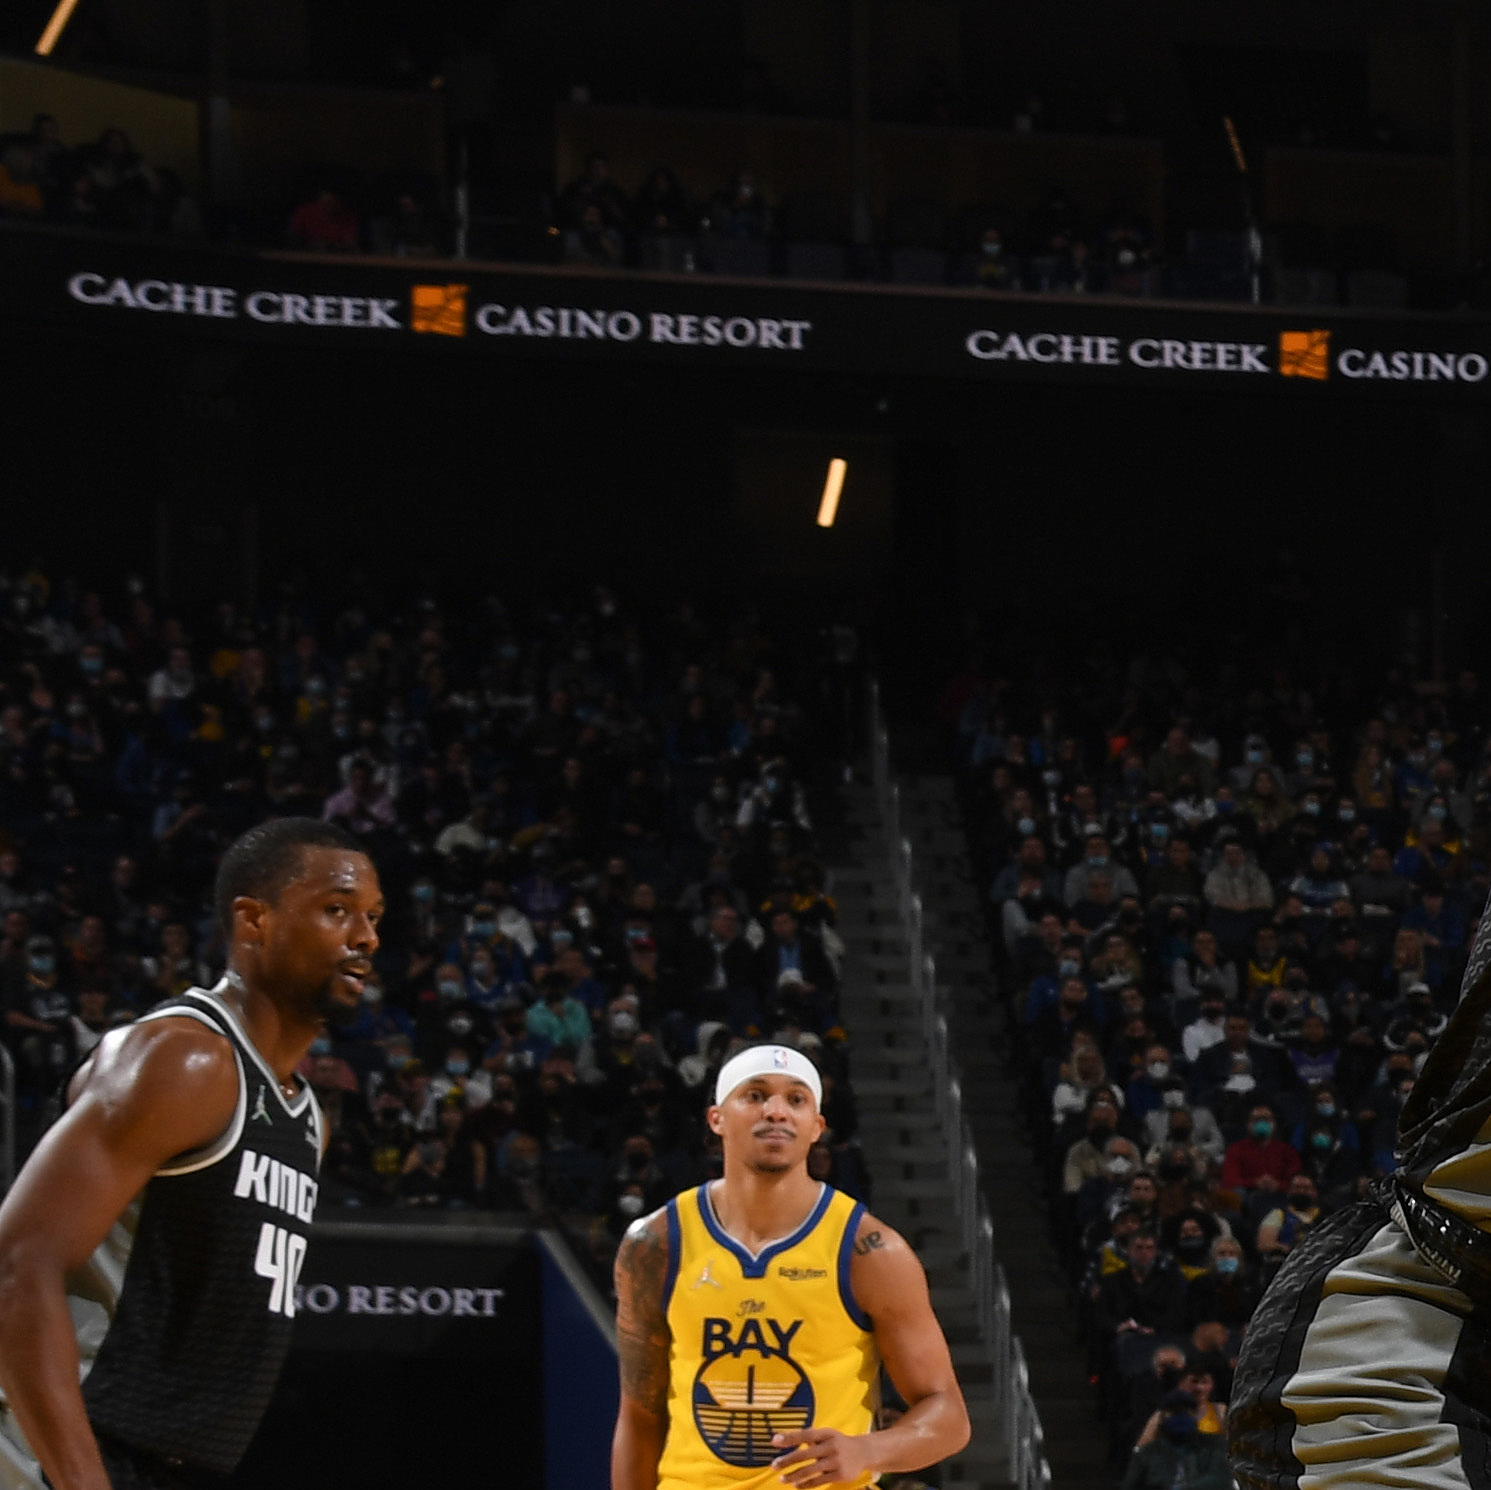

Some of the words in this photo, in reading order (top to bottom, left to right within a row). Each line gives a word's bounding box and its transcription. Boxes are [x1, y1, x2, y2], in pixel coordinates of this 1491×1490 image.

[68, 271, 236, 318] CACHE
[245, 291, 402, 330] CREEK
[475, 304, 642, 342] CASINO
[650, 312, 812, 351] RESORT
[965, 330, 1120, 367] CACHE
[1129, 338, 1270, 374] CREEK
[1338, 349, 1489, 384] CASINO
[233, 1148, 320, 1225] KING
[778, 1266, 828, 1280] Rakuten
[346, 1284, 504, 1318] RESORT
[702, 1317, 805, 1359] BAY
